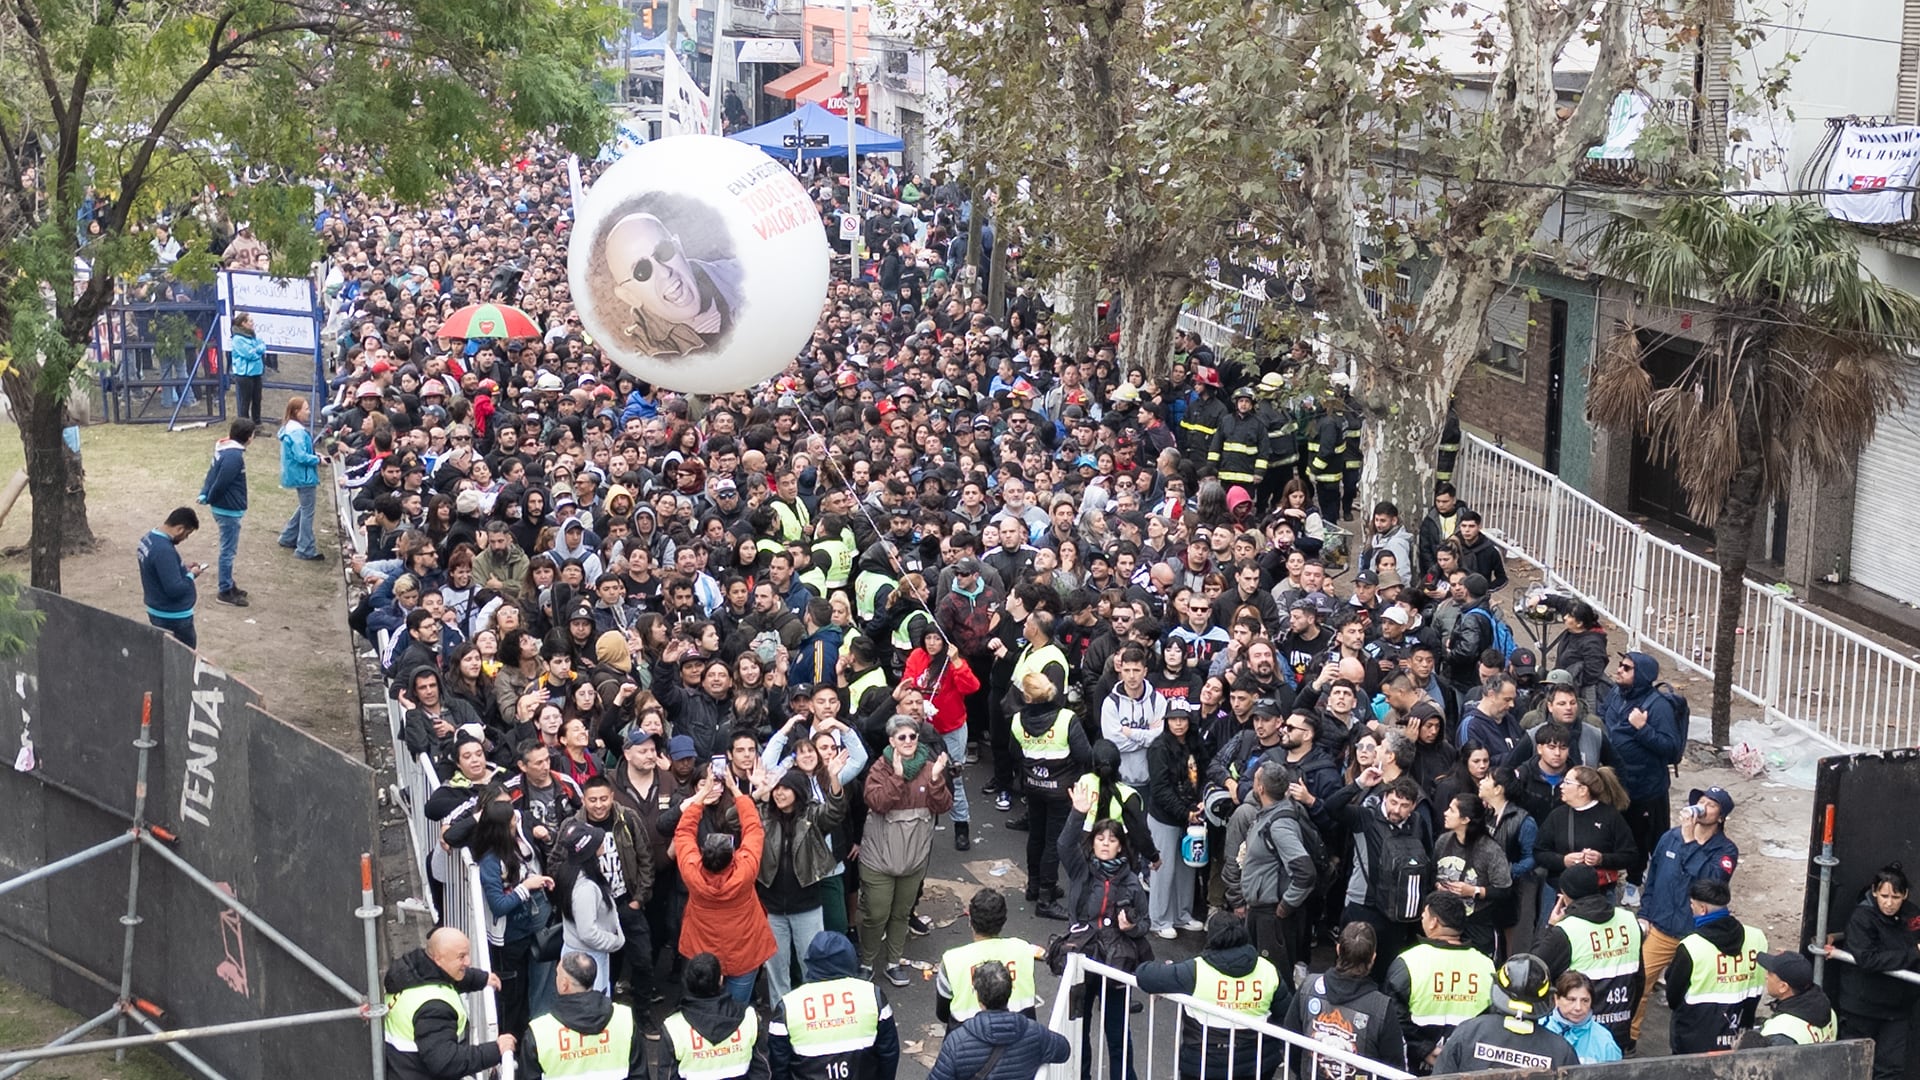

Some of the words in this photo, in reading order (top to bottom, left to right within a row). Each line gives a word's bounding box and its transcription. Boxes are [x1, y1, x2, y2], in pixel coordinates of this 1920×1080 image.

[827, 97, 861, 109] KIOSO
[741, 183, 783, 217] TODO
[752, 205, 800, 240] VALOR
[1590, 925, 1630, 952] GPS
[1716, 950, 1758, 975] GPS
[1217, 980, 1262, 1001] GPS
[1434, 971, 1478, 994] GPS
[803, 991, 856, 1020] GPS
[1606, 986, 1628, 1005] 482
[1477, 1045, 1547, 1069] BOMBEROS
[825, 1060, 849, 1079] 116
